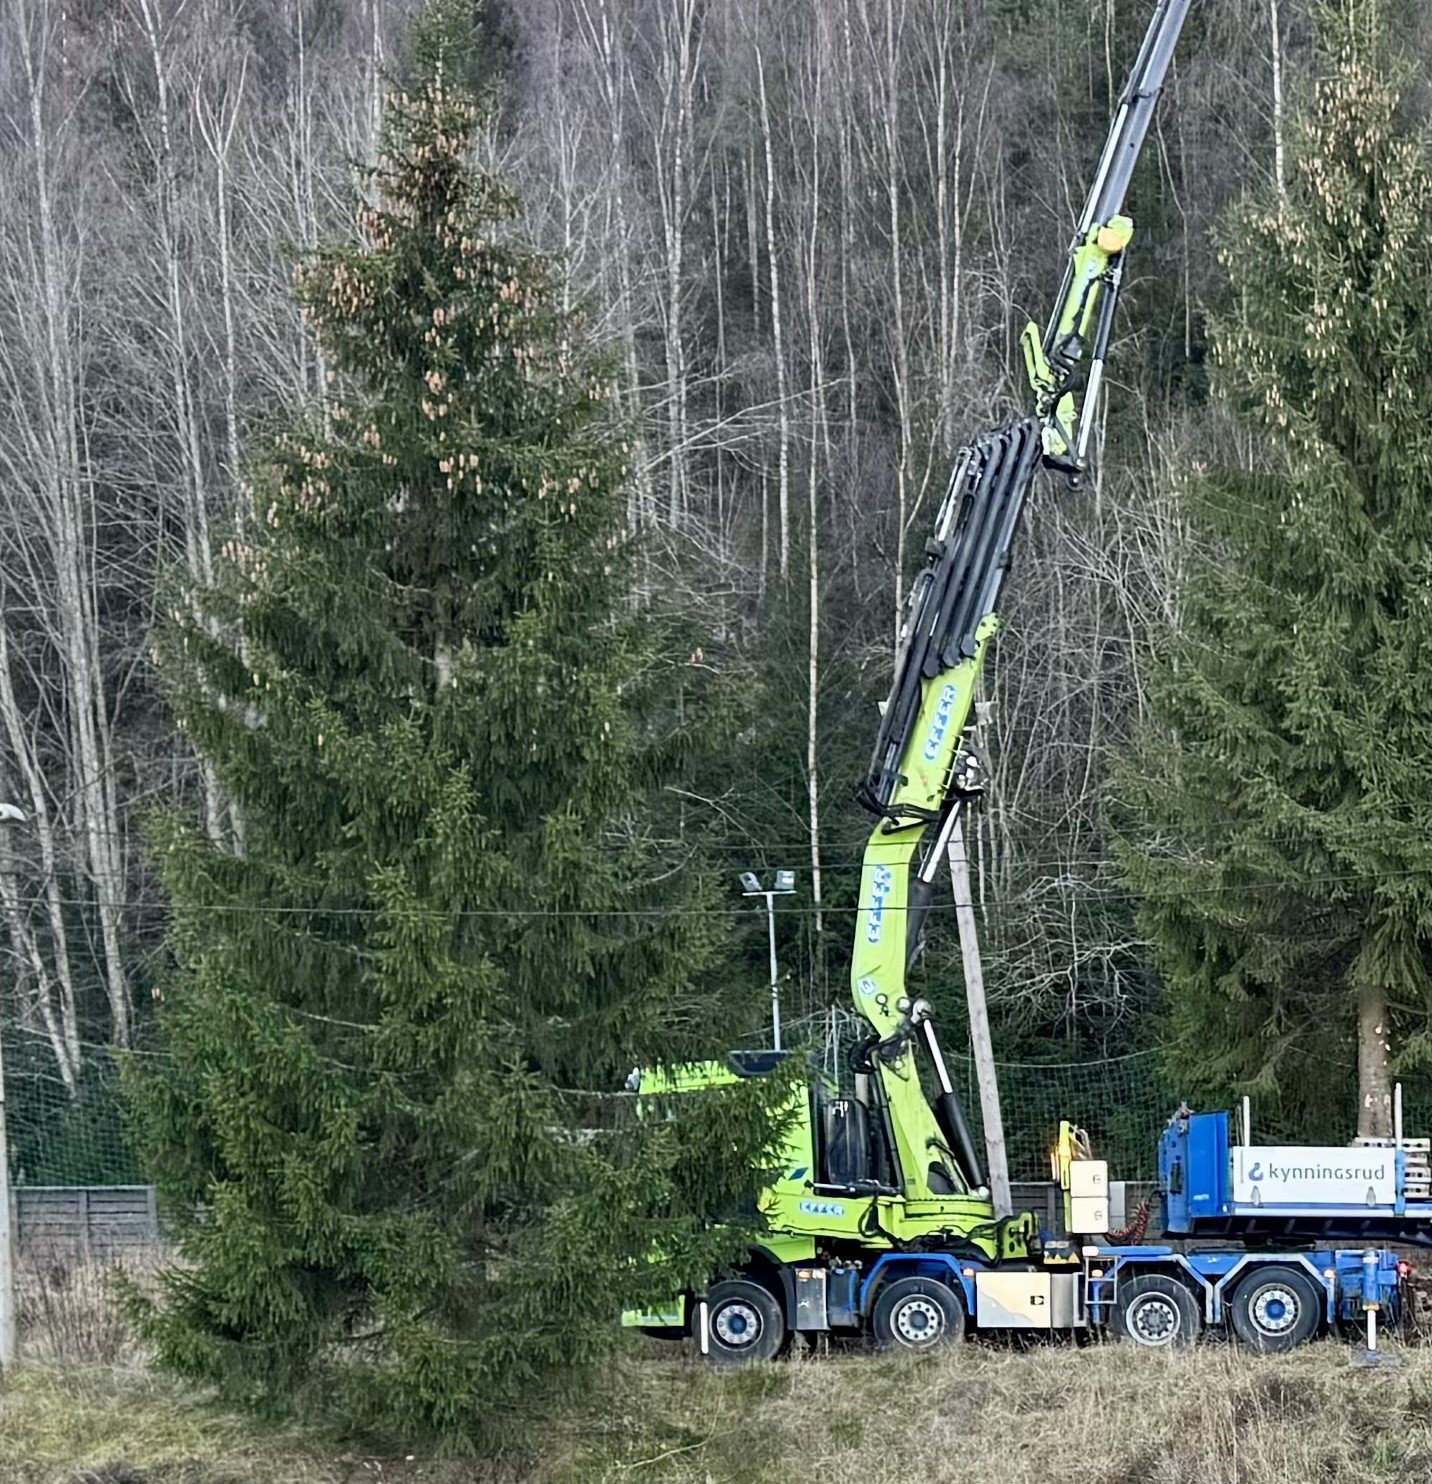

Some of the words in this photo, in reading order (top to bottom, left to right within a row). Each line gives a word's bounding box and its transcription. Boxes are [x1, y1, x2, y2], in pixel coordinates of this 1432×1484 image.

[925, 685, 957, 760] EFFER
[866, 866, 885, 944] EFFER
[1269, 1162, 1386, 1183] kynningsrud
[800, 1202, 845, 1216] EFFER
